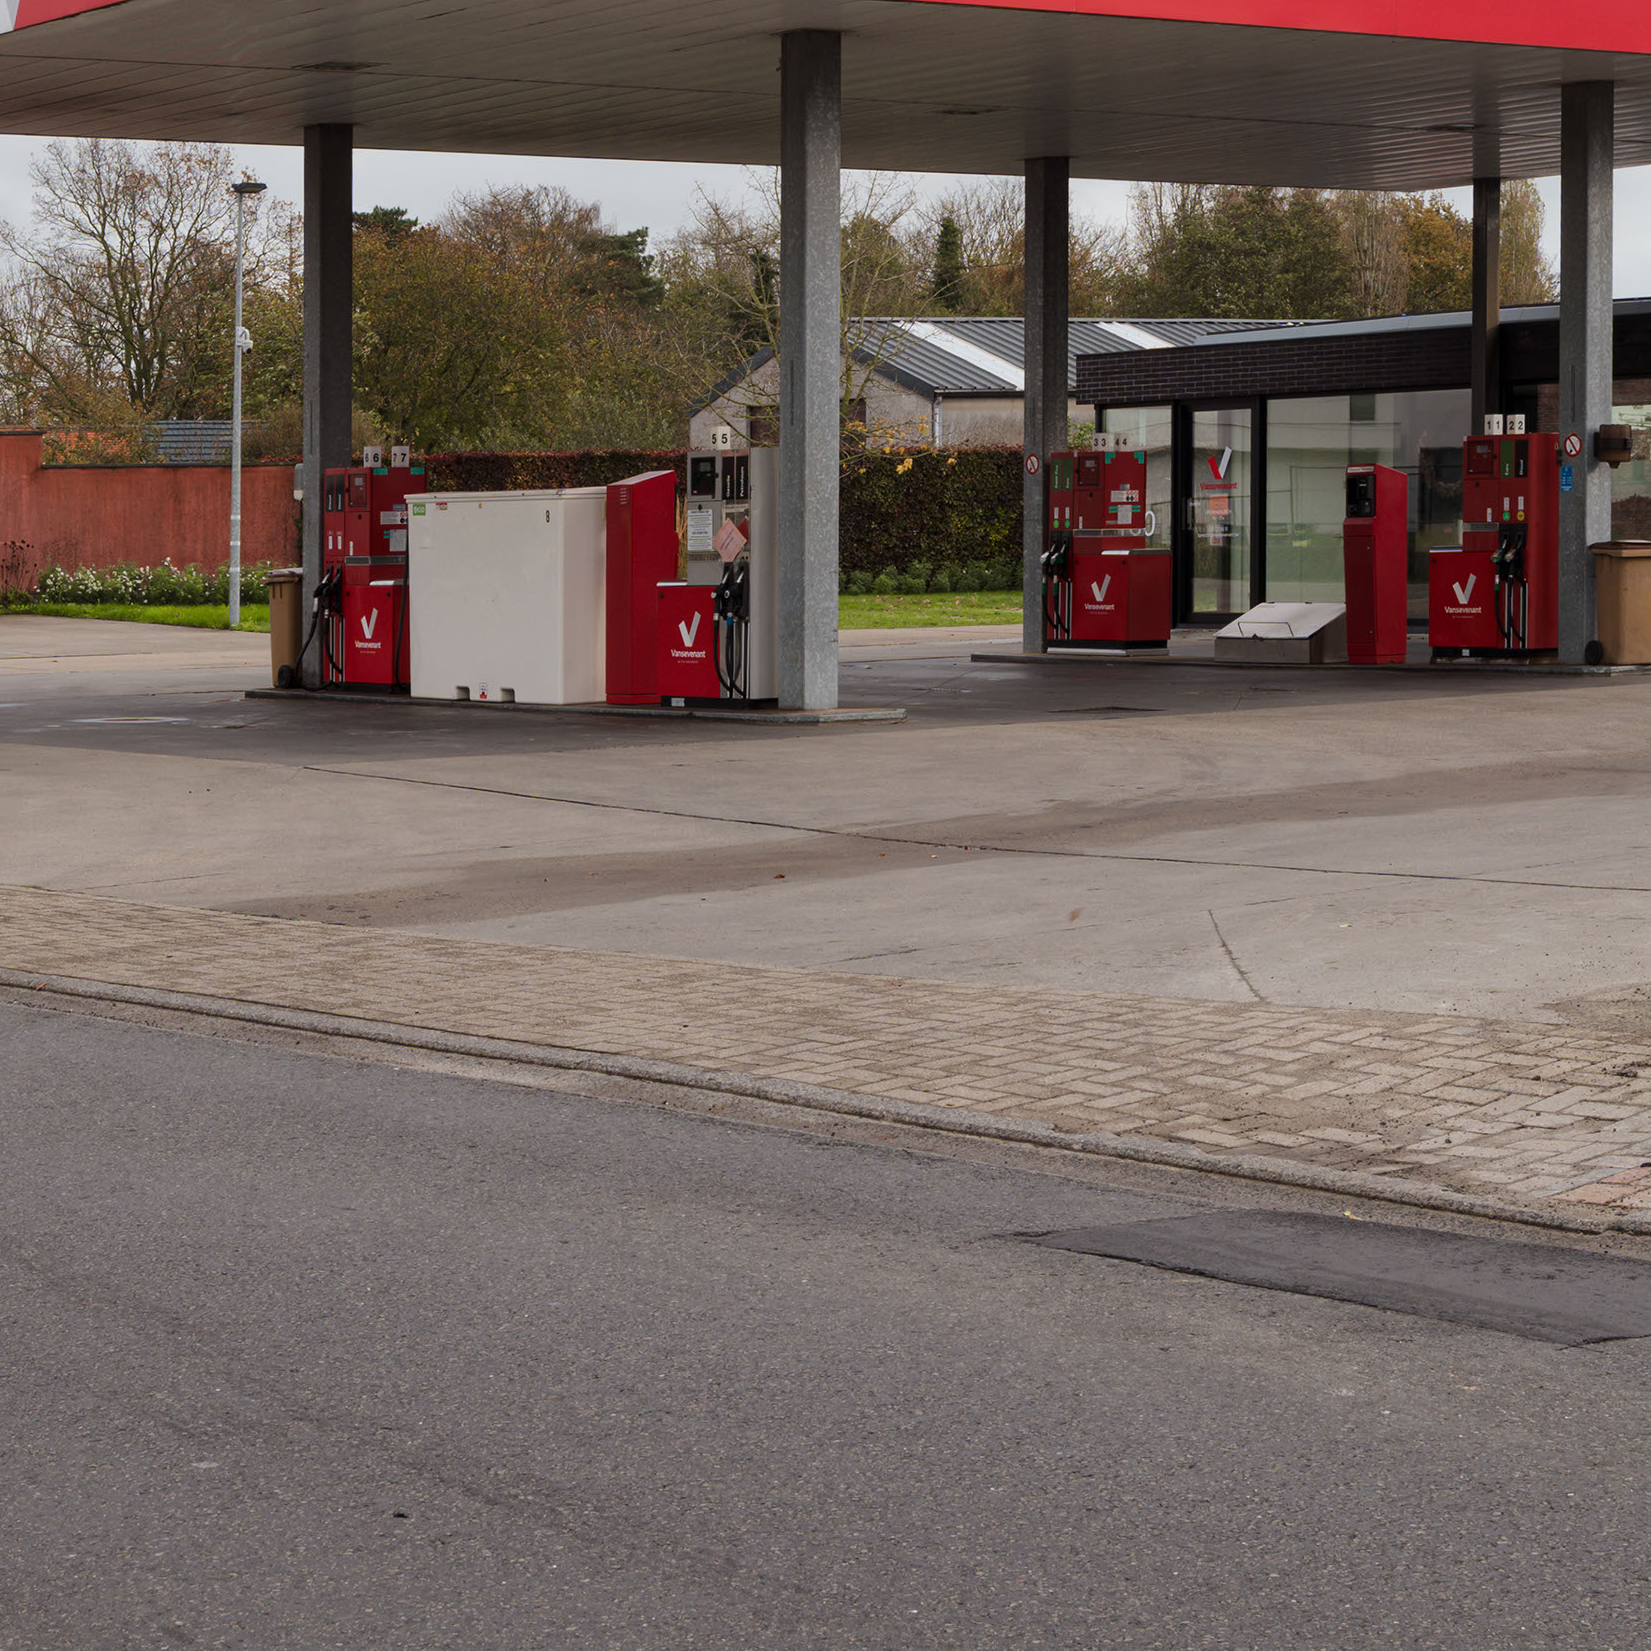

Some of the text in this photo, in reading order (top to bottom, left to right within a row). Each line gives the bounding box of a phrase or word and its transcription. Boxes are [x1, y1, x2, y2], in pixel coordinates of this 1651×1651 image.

[1509, 421, 1514, 429] 2
[1518, 421, 1523, 429] 2
[711, 433, 717, 444] 5
[721, 433, 728, 444] 5
[1093, 438, 1099, 446] 3
[1101, 438, 1106, 446] 3
[1115, 438, 1120, 446] 4
[1122, 438, 1127, 446] 4
[365, 452, 369, 463] 6
[373, 452, 380, 463] 6
[400, 452, 407, 462] 7
[545, 509, 550, 523] 8
